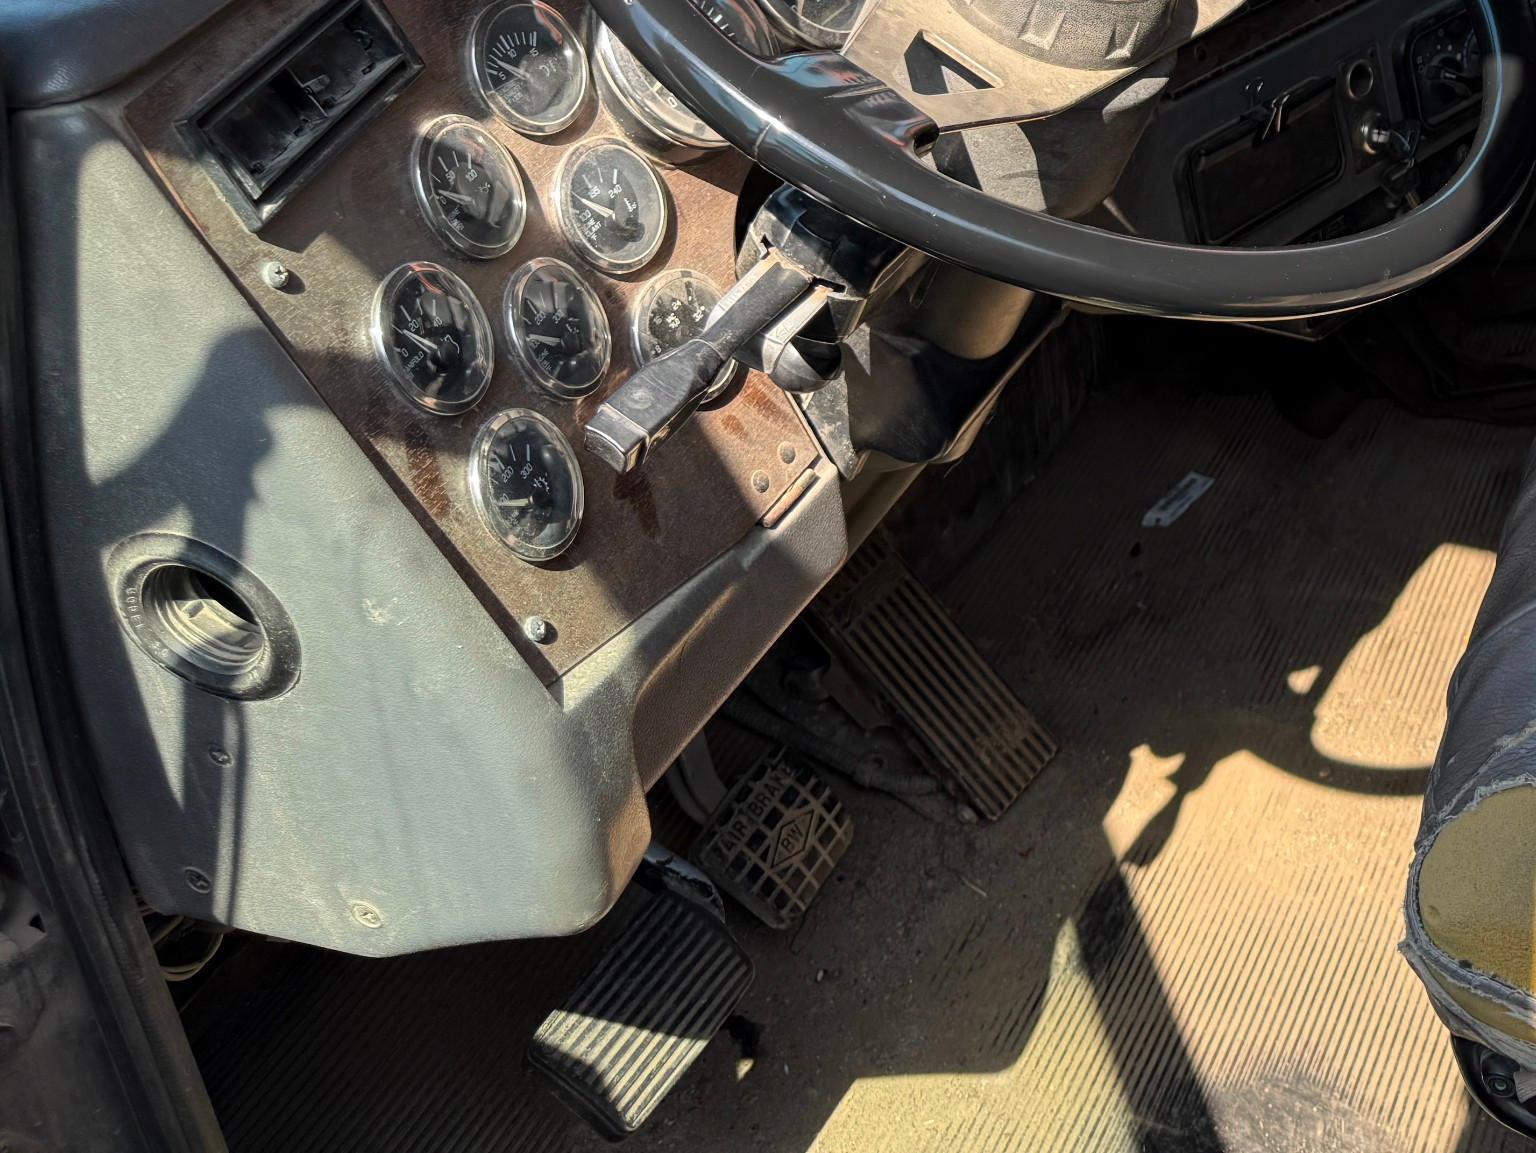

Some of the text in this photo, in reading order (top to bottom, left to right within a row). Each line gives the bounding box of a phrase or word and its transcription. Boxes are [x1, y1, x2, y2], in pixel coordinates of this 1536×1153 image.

[608, 184, 623, 199] 240
[671, 299, 682, 311] 24
[408, 318, 419, 333] 20
[432, 315, 443, 328] 40
[401, 347, 409, 358] 0
[501, 465, 515, 483] 200
[520, 462, 534, 480] 300
